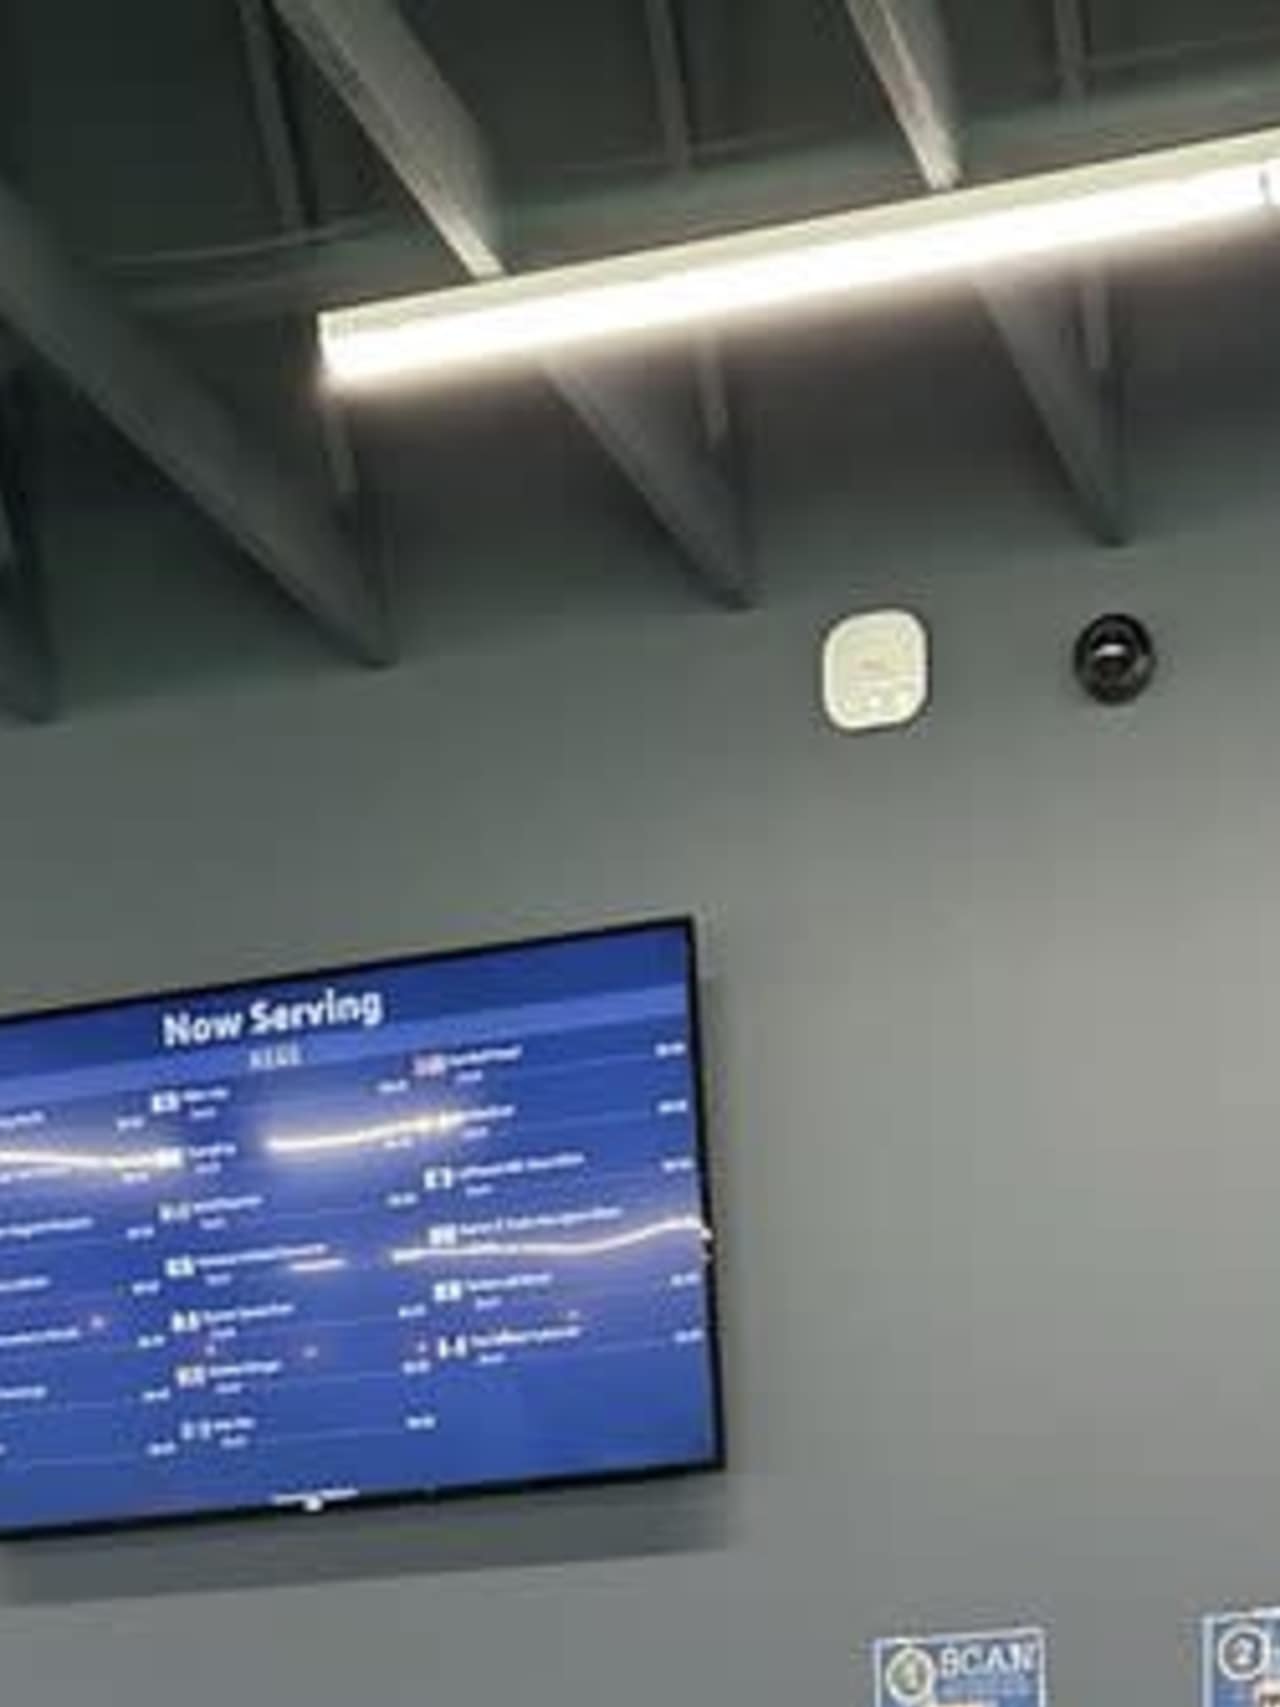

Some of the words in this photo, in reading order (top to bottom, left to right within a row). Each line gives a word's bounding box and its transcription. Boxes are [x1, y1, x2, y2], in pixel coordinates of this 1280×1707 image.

[163, 1011, 243, 1048] Now
[249, 987, 384, 1036] Serving
[939, 1644, 1038, 1679] SCAN
